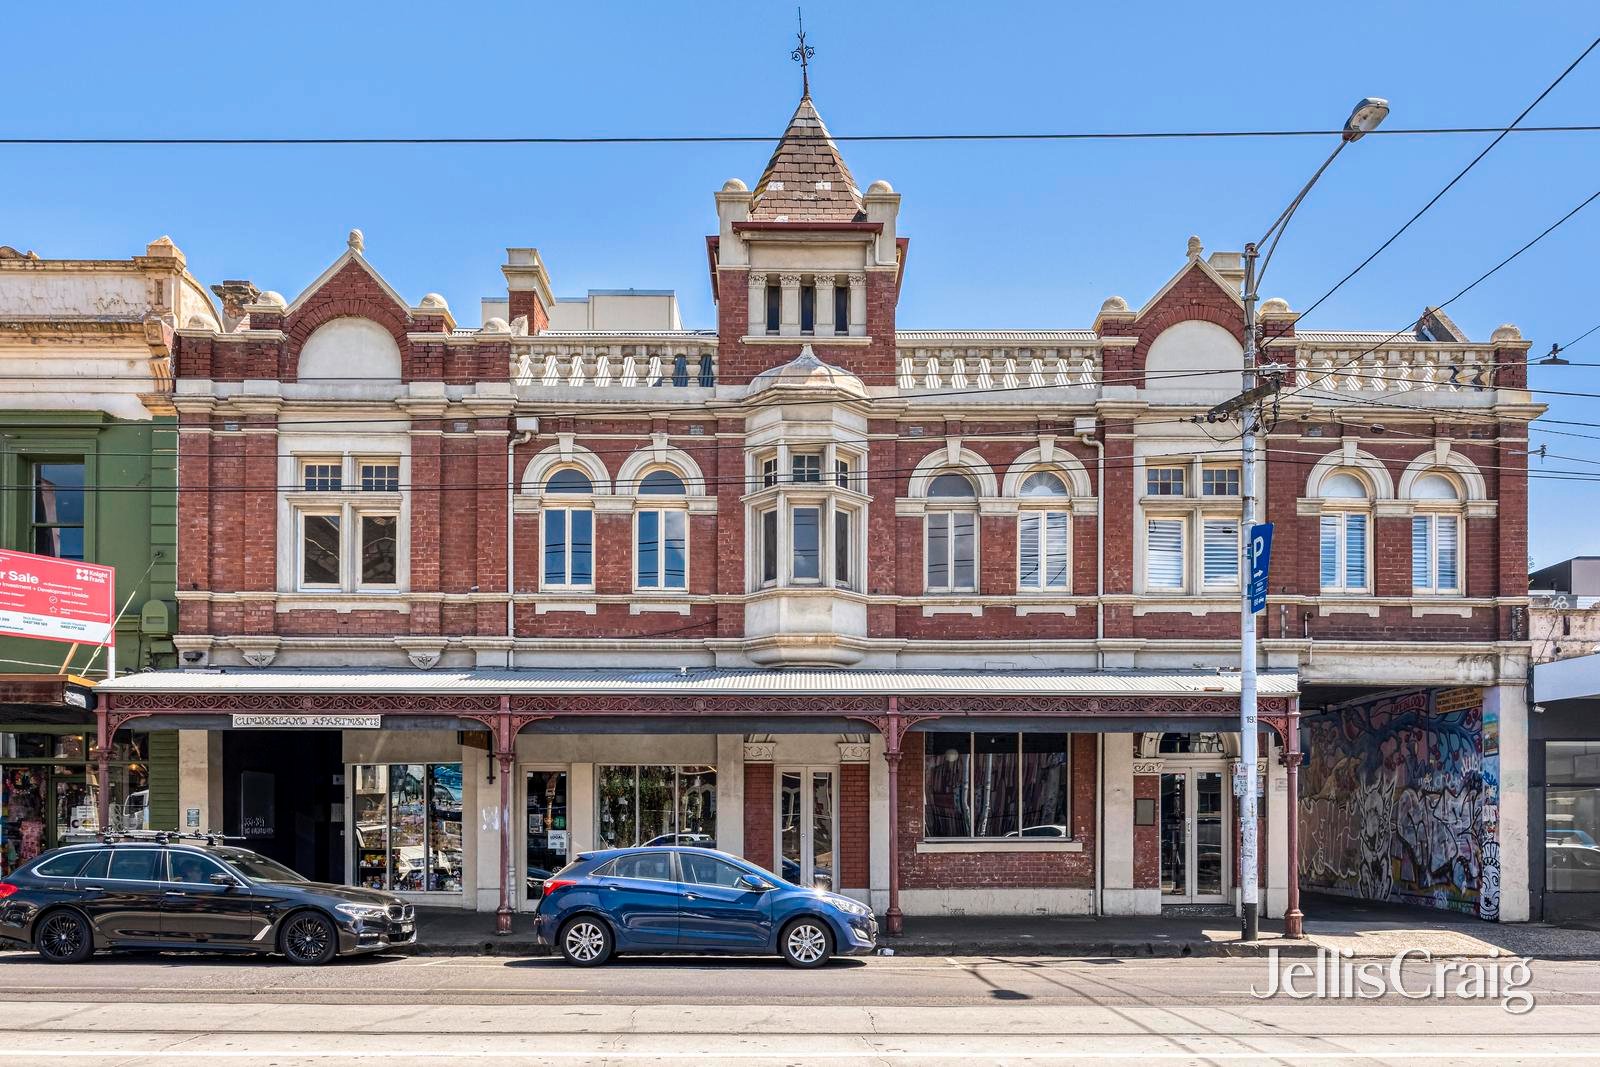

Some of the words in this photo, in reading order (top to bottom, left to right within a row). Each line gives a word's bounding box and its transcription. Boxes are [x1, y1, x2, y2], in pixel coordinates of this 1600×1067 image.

[1254, 536, 1264, 568] P
[8, 570, 39, 584] Sale
[89, 570, 108, 579] Knight
[89, 576, 105, 584] Frank
[2, 582, 32, 591] Investment
[37, 586, 71, 596] Development
[234, 716, 308, 726] CUMBERLAND
[312, 716, 379, 727] APARTMENTS
